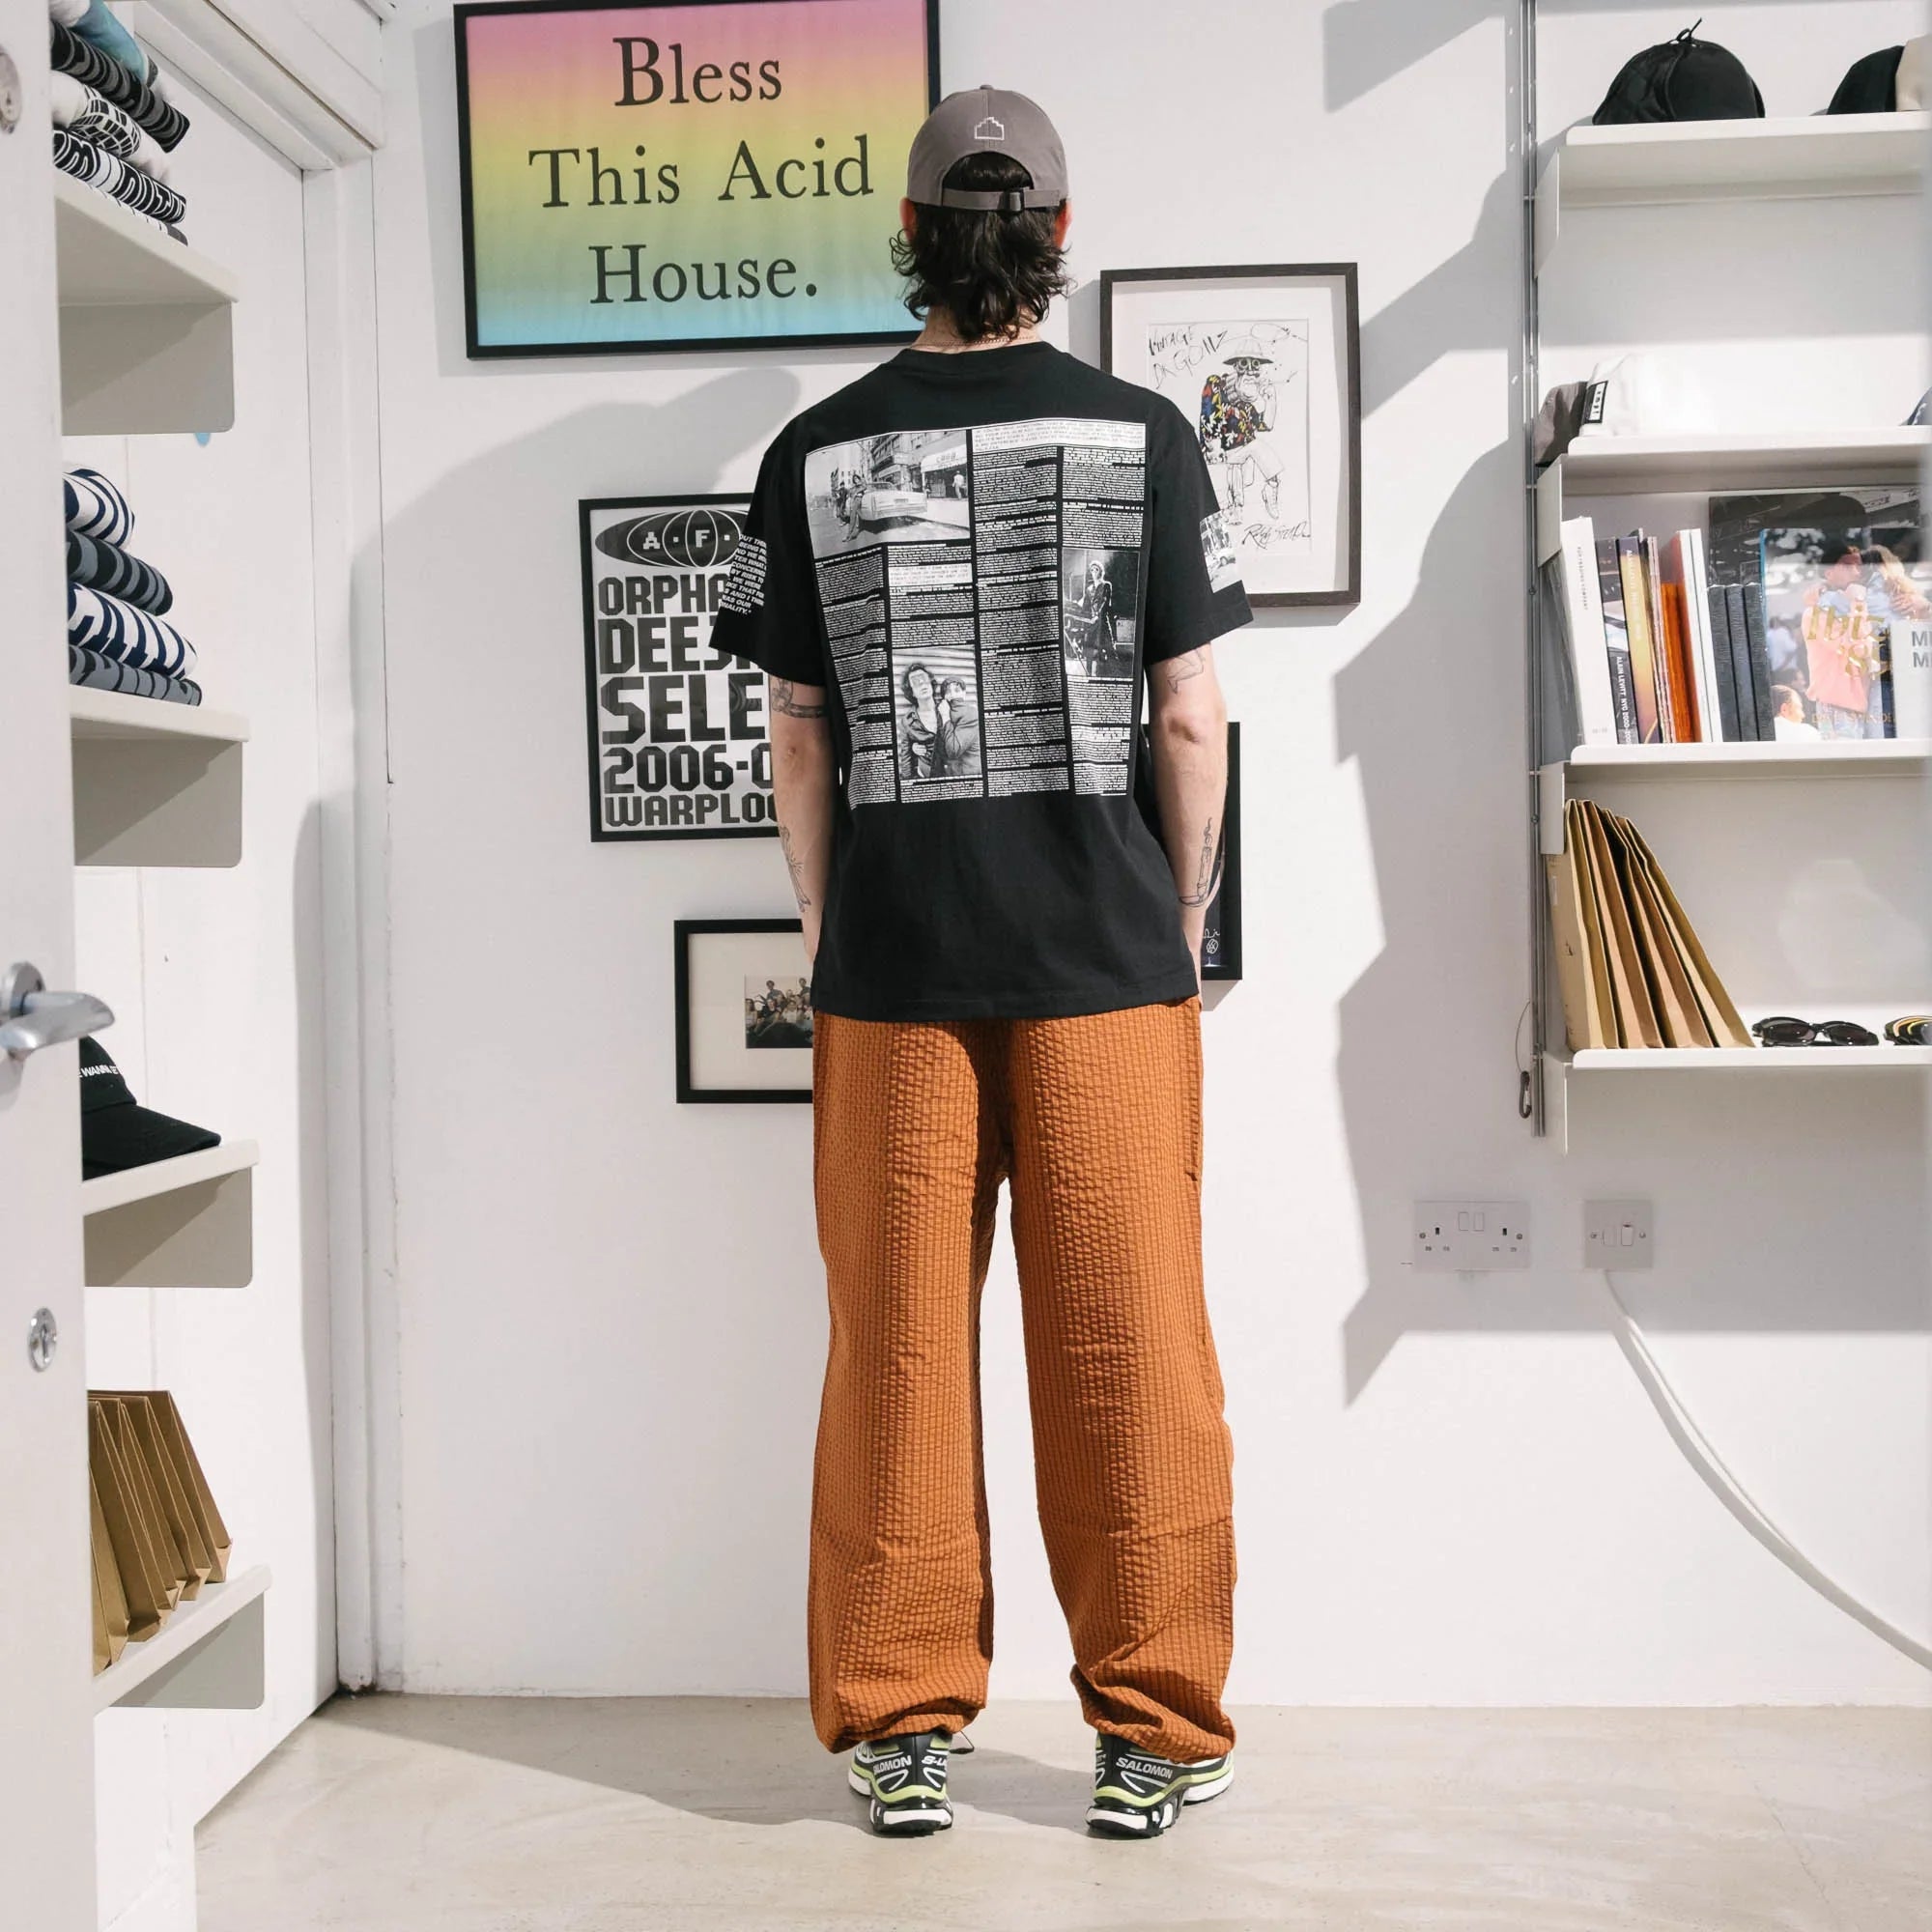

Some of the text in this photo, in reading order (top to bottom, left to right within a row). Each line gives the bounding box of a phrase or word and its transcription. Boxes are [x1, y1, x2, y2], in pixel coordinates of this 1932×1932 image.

[612, 37, 781, 106] Bless
[528, 133, 874, 208] This Acid
[587, 243, 817, 304] House.
[730, 590, 746, 600] AND
[738, 585, 756, 595] THAT
[736, 599, 752, 609] OUR
[1616, 656, 1625, 674] ALAIN
[1618, 675, 1627, 696] LEVITT
[1623, 711, 1632, 744] 2000-200
[1116, 1757, 1174, 1779] SALOMON
